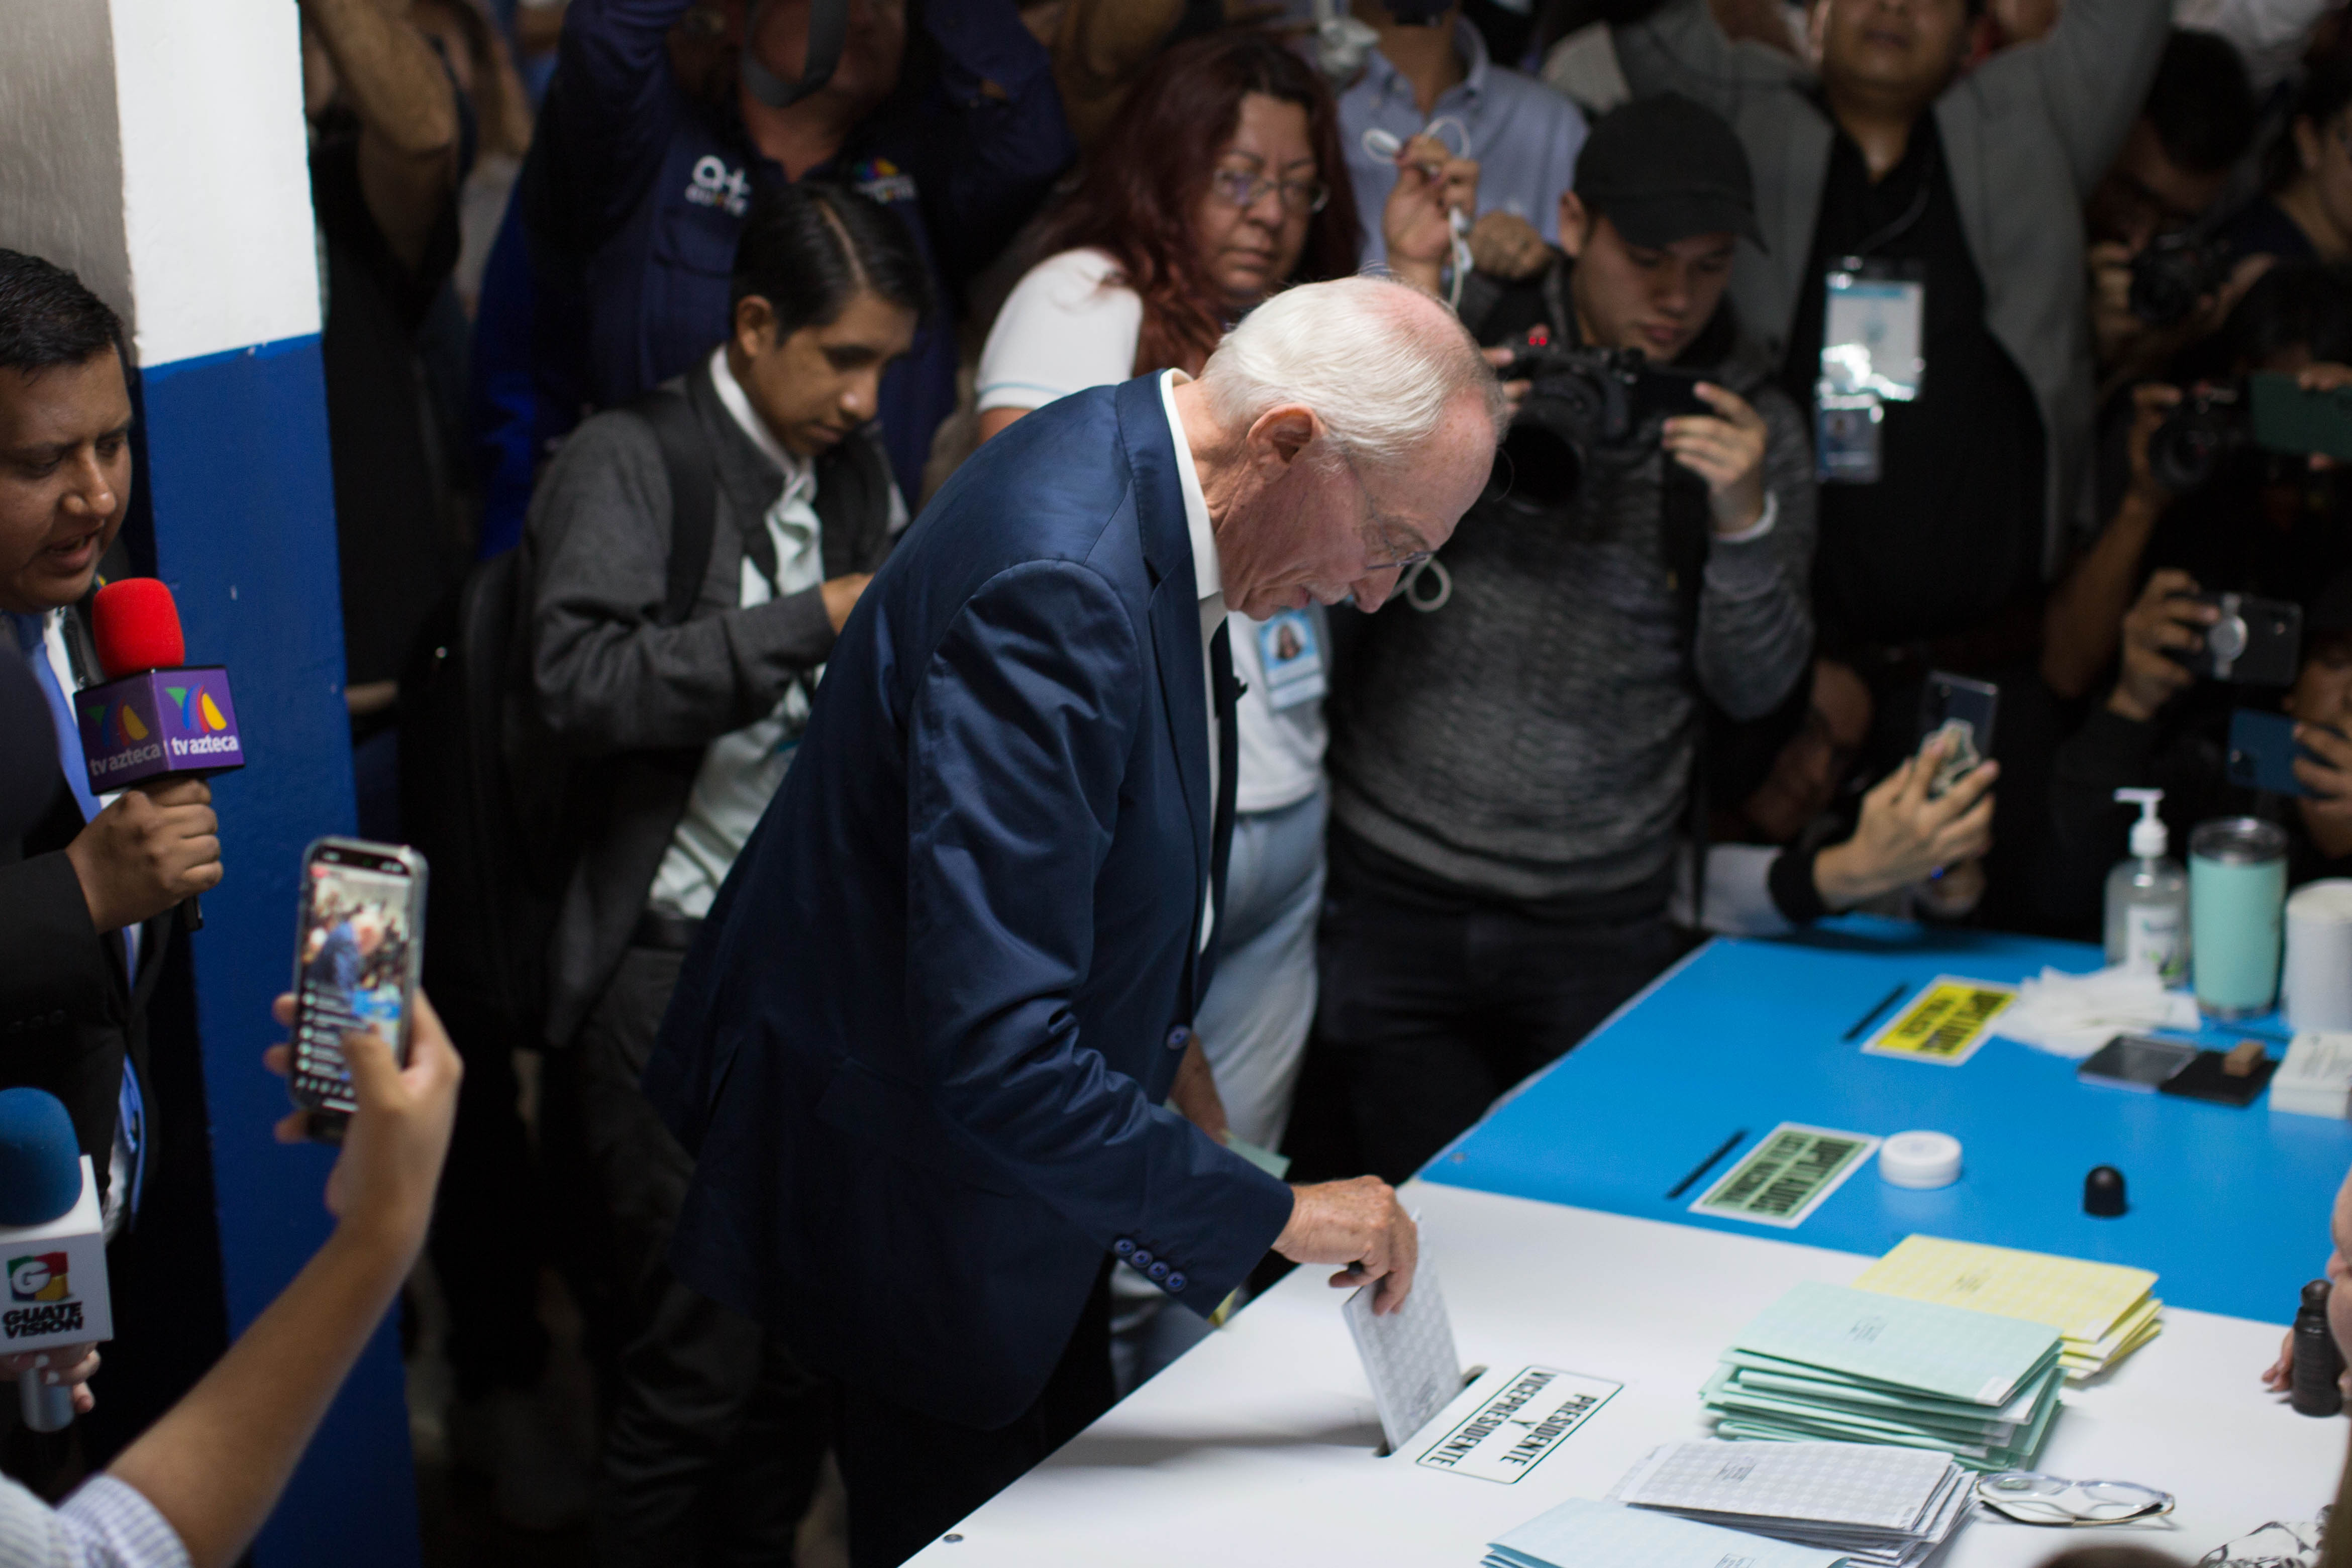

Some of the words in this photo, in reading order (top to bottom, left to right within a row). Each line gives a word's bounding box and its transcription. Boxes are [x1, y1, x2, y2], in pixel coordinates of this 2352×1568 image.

[171, 736, 189, 756] tv
[189, 734, 239, 754] azteca
[90, 757, 107, 776] tv
[109, 742, 161, 772] azteca
[3, 1301, 82, 1325] GUATE
[5, 1316, 84, 1339] VISION
[1427, 1372, 1558, 1467] VICEPRESIDENTE
[1499, 1393, 1599, 1466] PRESIDENTE
[1509, 1419, 1539, 1430] Y
